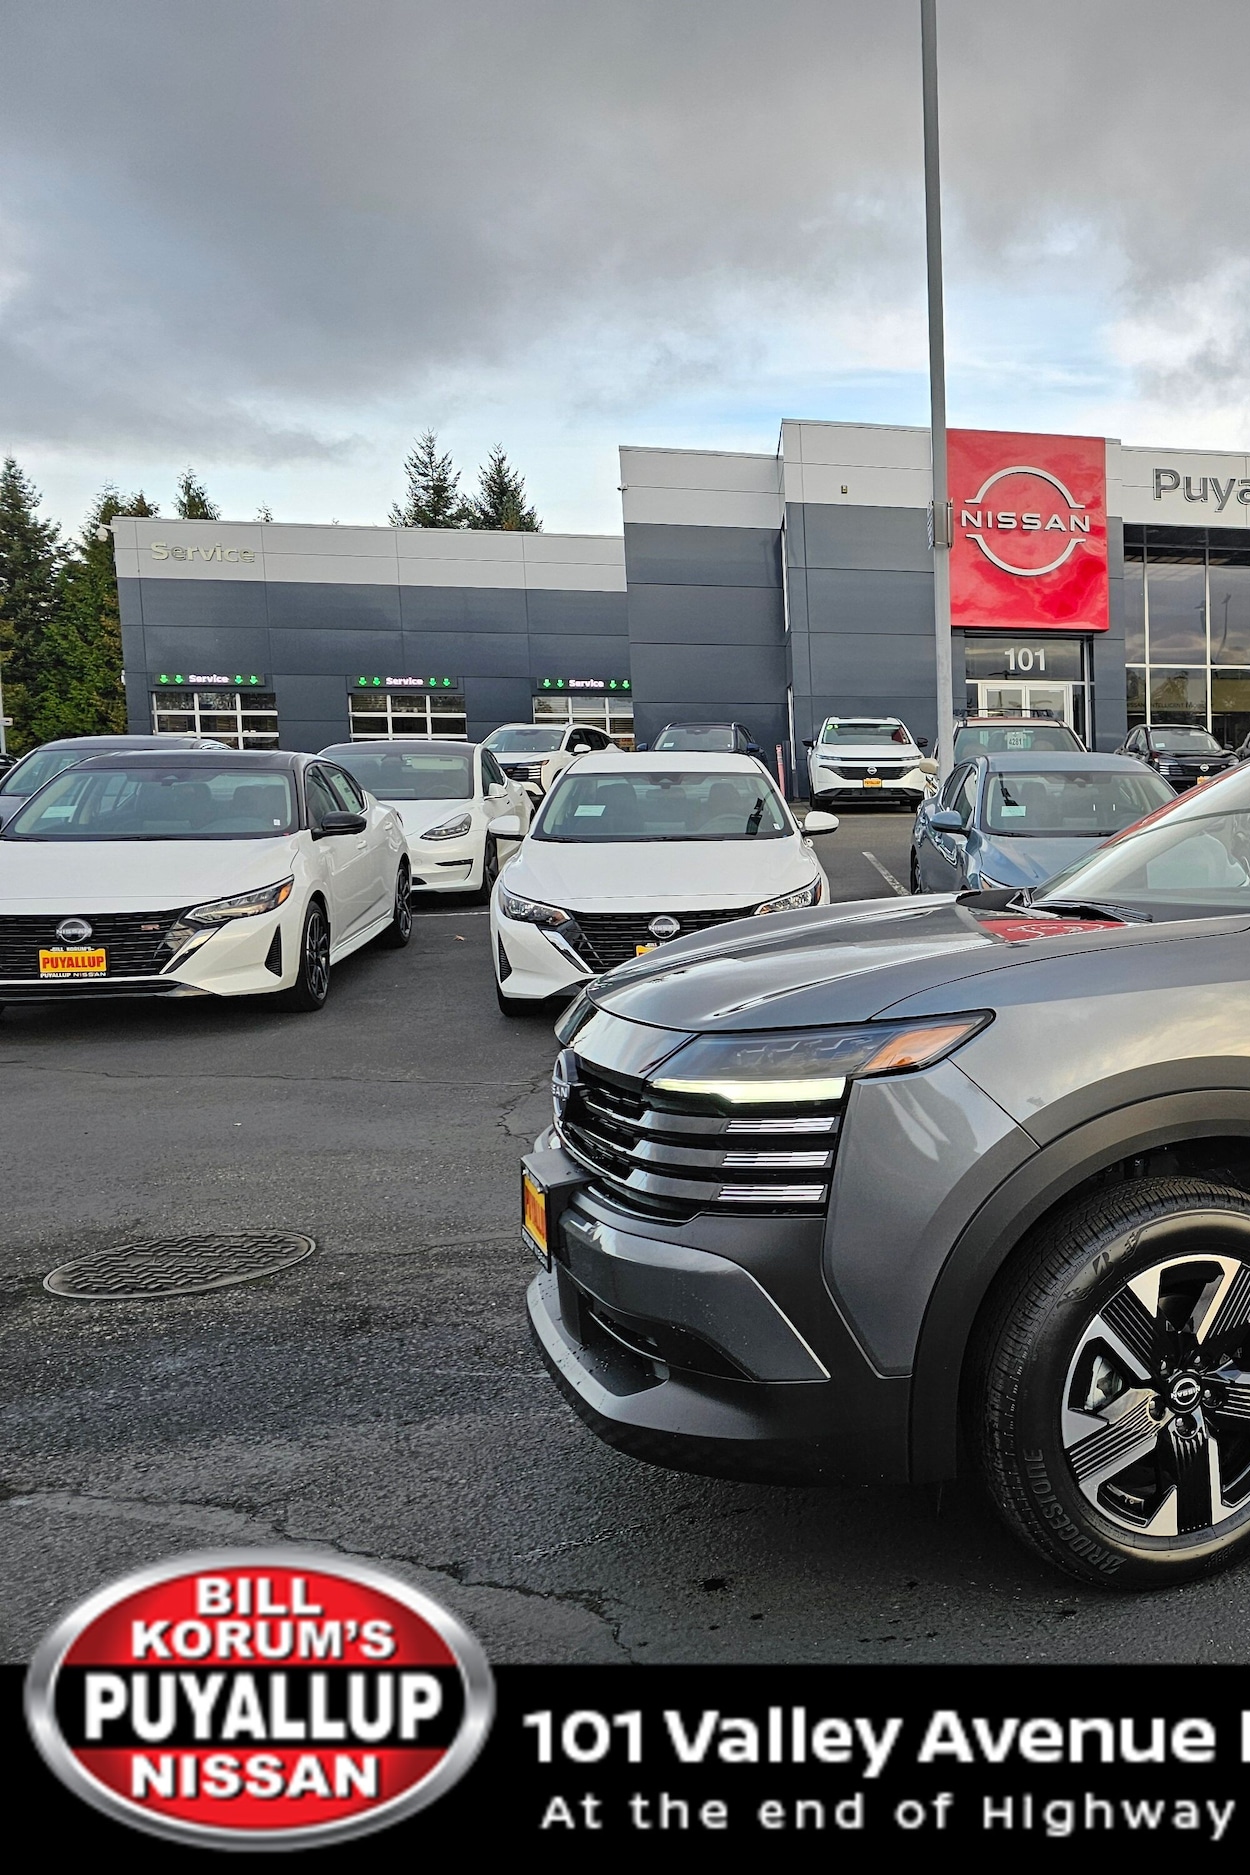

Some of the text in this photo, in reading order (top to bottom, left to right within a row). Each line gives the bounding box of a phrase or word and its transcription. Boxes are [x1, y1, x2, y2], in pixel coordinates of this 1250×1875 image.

[961, 509, 1090, 533] NISSAN
[151, 541, 256, 563] Service
[1004, 647, 1046, 671] 101
[188, 674, 230, 683] Service
[386, 677, 424, 685] Service
[568, 679, 605, 688] Service
[42, 956, 105, 969] PUYALLUP
[1022, 1449, 1128, 1574] BRIDGESTONE
